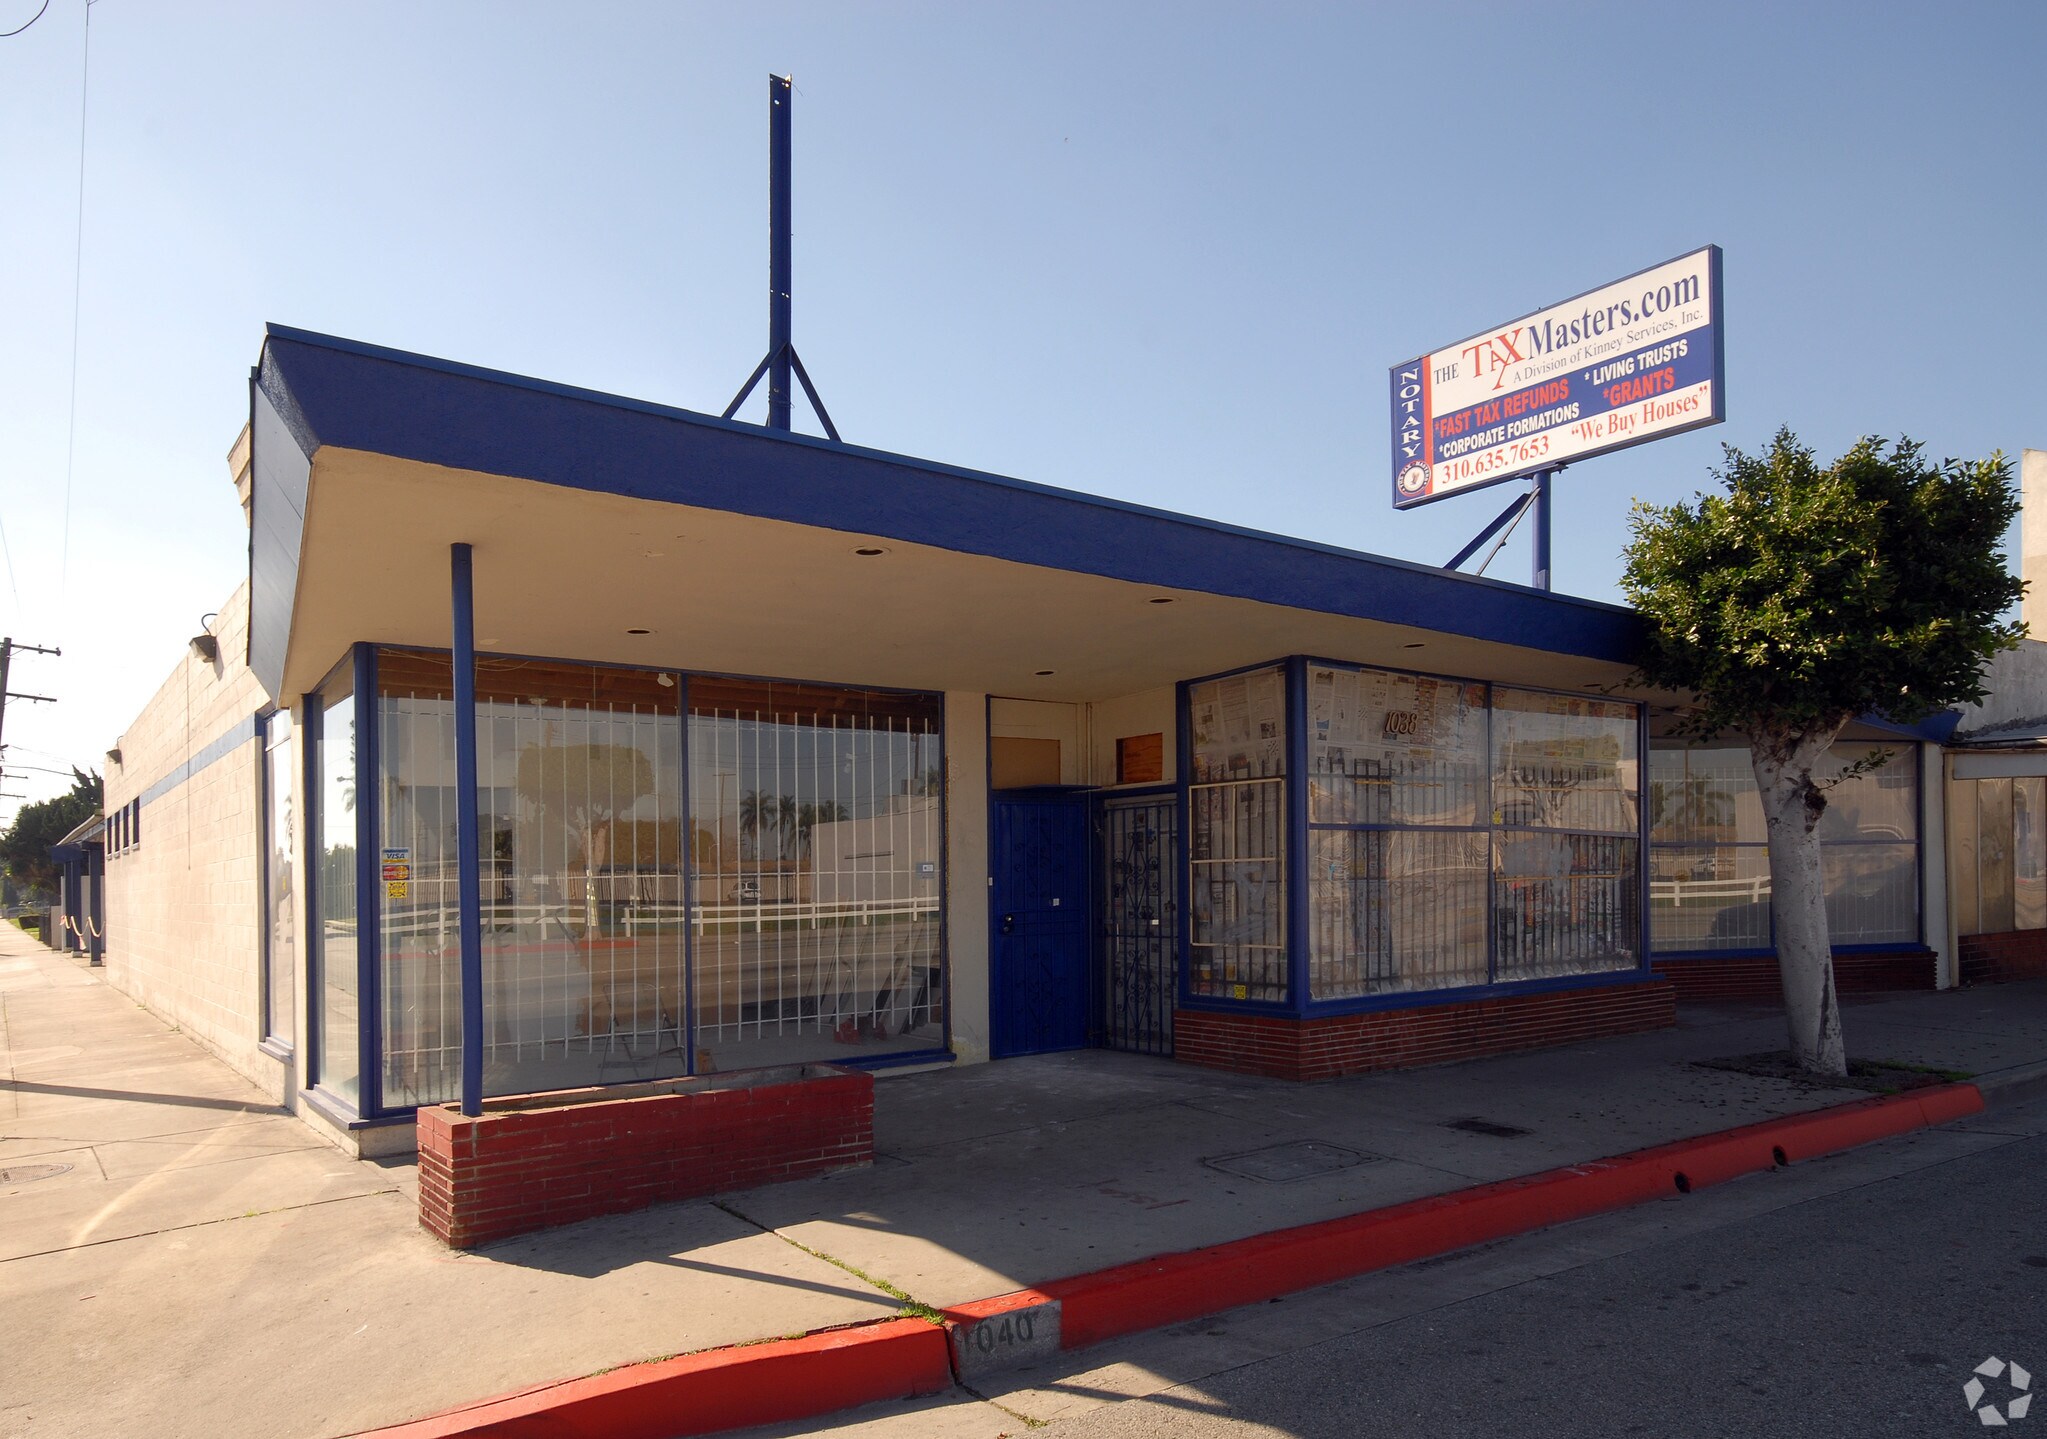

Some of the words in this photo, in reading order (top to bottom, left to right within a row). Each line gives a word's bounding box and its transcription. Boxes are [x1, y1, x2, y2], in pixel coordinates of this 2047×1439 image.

[1513, 371, 1522, 383] A
[1524, 359, 1567, 380] Division
[1570, 350, 1582, 363] of
[1584, 336, 1623, 359] Kinney
[1627, 320, 1677, 344] Services,
[1682, 308, 1703, 325] Inc.
[1593, 357, 1635, 386] LIVING
[1637, 339, 1688, 371] TRUSTS
[1434, 363, 1459, 385] THE
[1400, 368, 1421, 458] NOTARY
[1474, 401, 1501, 427] TAX
[1503, 378, 1570, 419] REFUNDS
[1507, 402, 1580, 437] FORMATIONS
[1608, 413, 1638, 435] Buy
[1442, 435, 1549, 485] 310.635.7653
[1385, 711, 1418, 735] 1038
